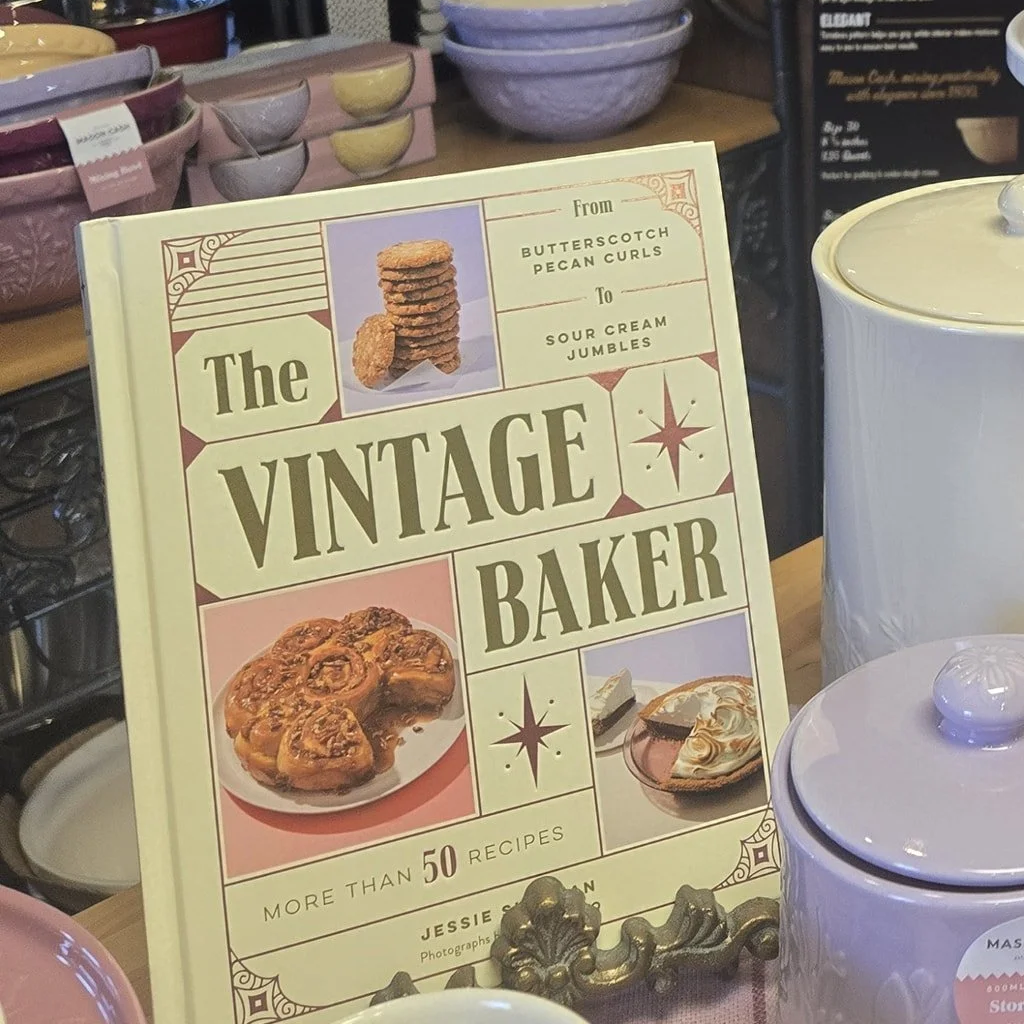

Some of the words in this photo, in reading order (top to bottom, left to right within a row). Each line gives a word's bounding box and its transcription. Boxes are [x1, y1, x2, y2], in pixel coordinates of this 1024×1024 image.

[819, 12, 872, 28] ELEGANT
[573, 198, 613, 218] From
[521, 226, 670, 259] BUTTERSCOTCH
[533, 255, 595, 275] PECAN
[604, 245, 663, 265] CURLS
[595, 286, 613, 305] To
[545, 328, 596, 346] SOUR
[604, 315, 667, 337] CREAM
[567, 336, 652, 361] JUMBLES
[203, 349, 310, 416] The
[217, 402, 596, 570] VINTAGE
[475, 516, 728, 654] BAKER
[263, 888, 336, 923] MORE
[345, 866, 412, 899] THAN
[422, 844, 457, 884] 50
[467, 825, 565, 865] RECIPES
[421, 909, 492, 941] JESSIE
[420, 935, 491, 963] Photographs
